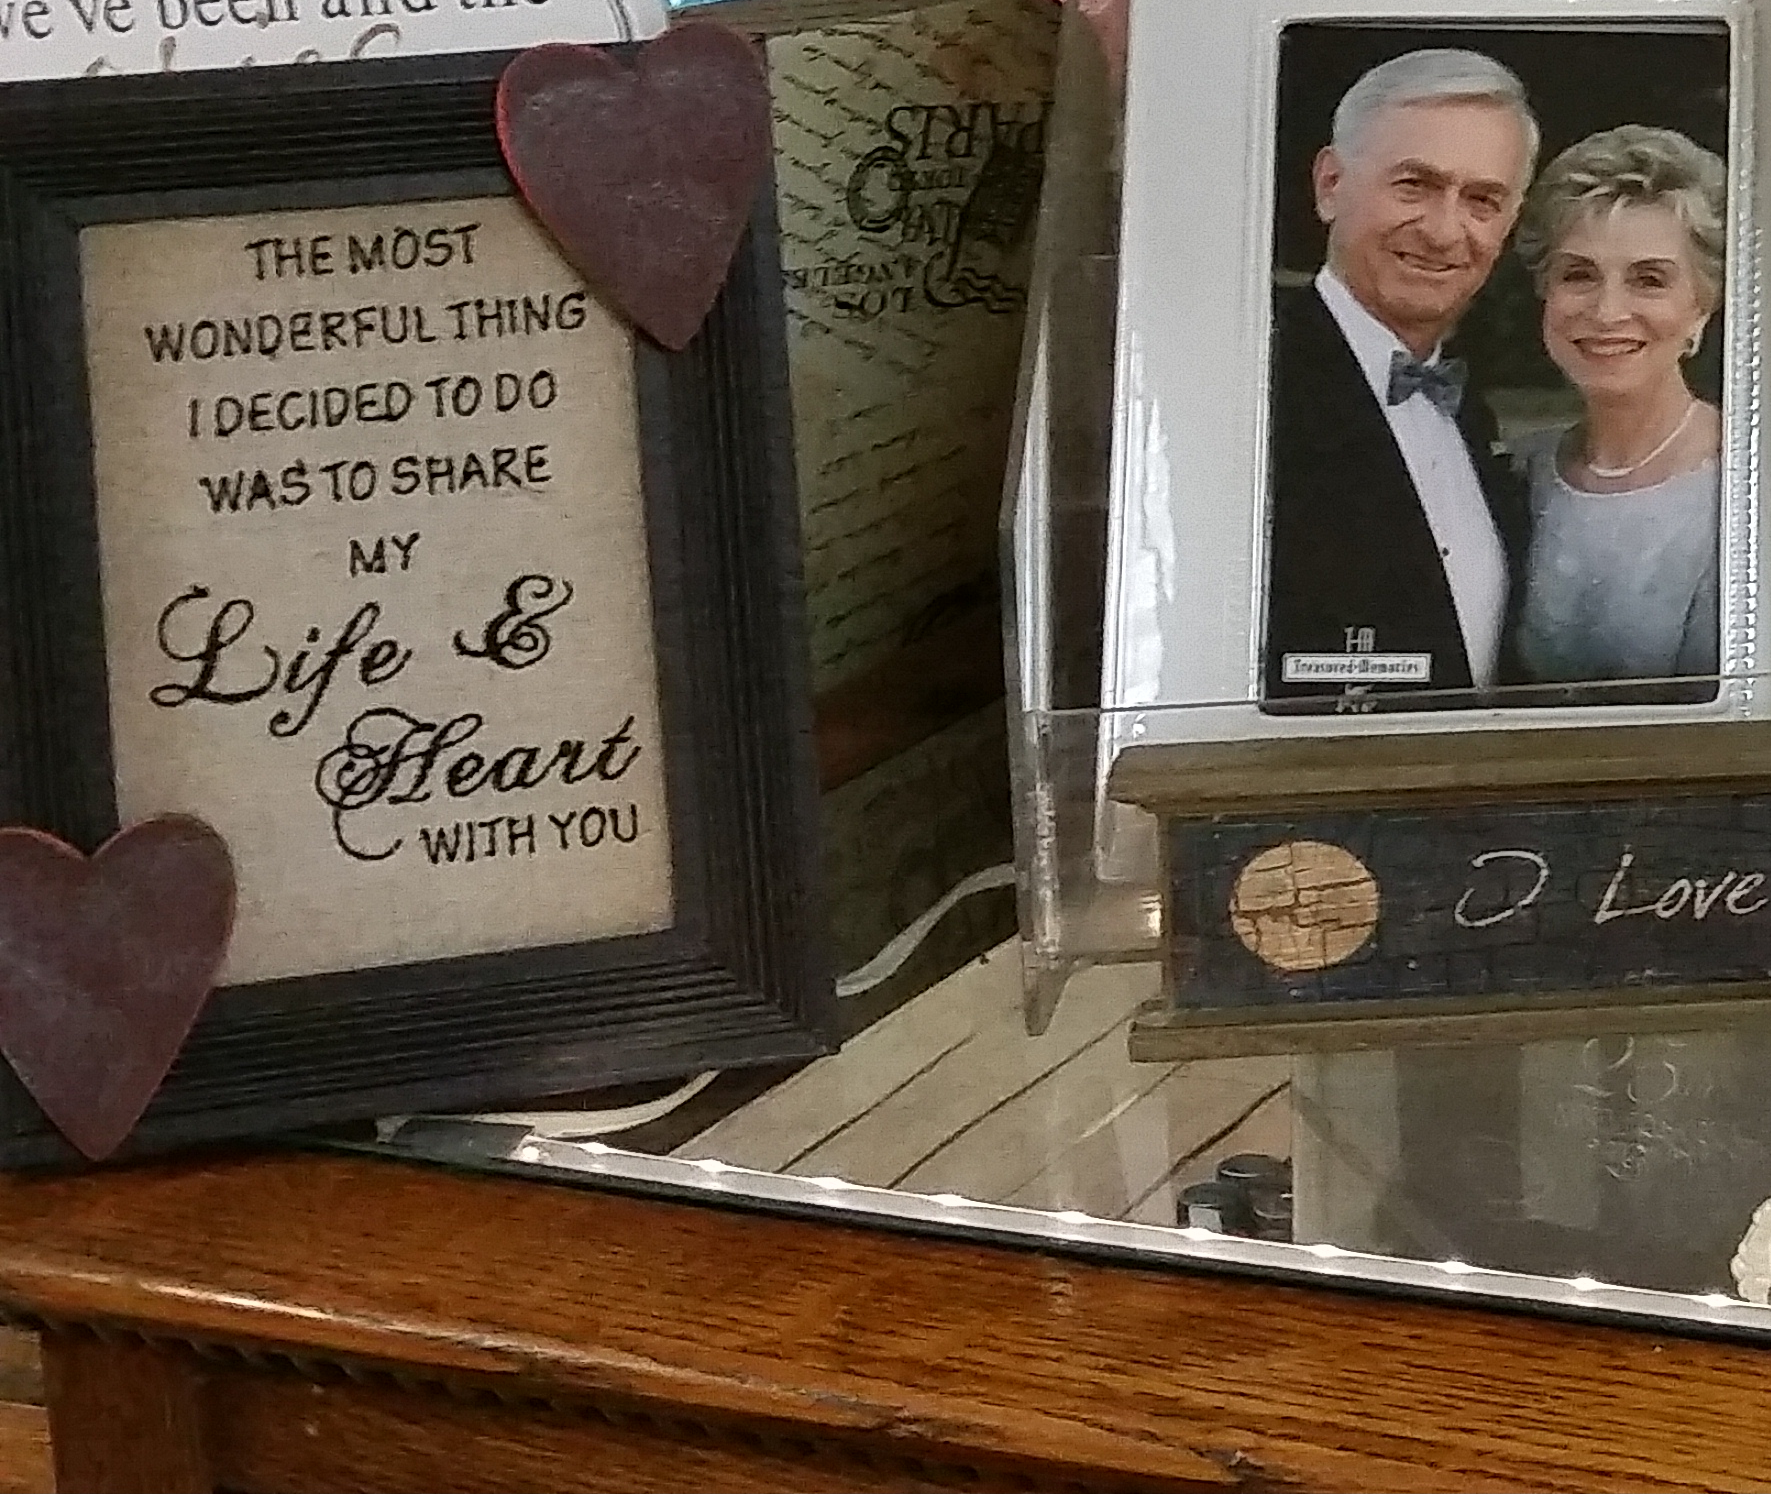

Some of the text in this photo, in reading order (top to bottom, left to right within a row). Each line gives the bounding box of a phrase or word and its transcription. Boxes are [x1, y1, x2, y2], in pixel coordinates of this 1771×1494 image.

[245, 224, 481, 283] THE MOST
[145, 291, 590, 365] WONDERFUL THING
[186, 369, 558, 439] I DECIDED TO DO
[201, 444, 553, 513] WAS TO SHARE
[348, 532, 421, 579] MY
[148, 573, 574, 738] Life &
[315, 707, 643, 862] Heart
[420, 803, 640, 866] WITH YOU
[1595, 843, 1768, 926] Love
